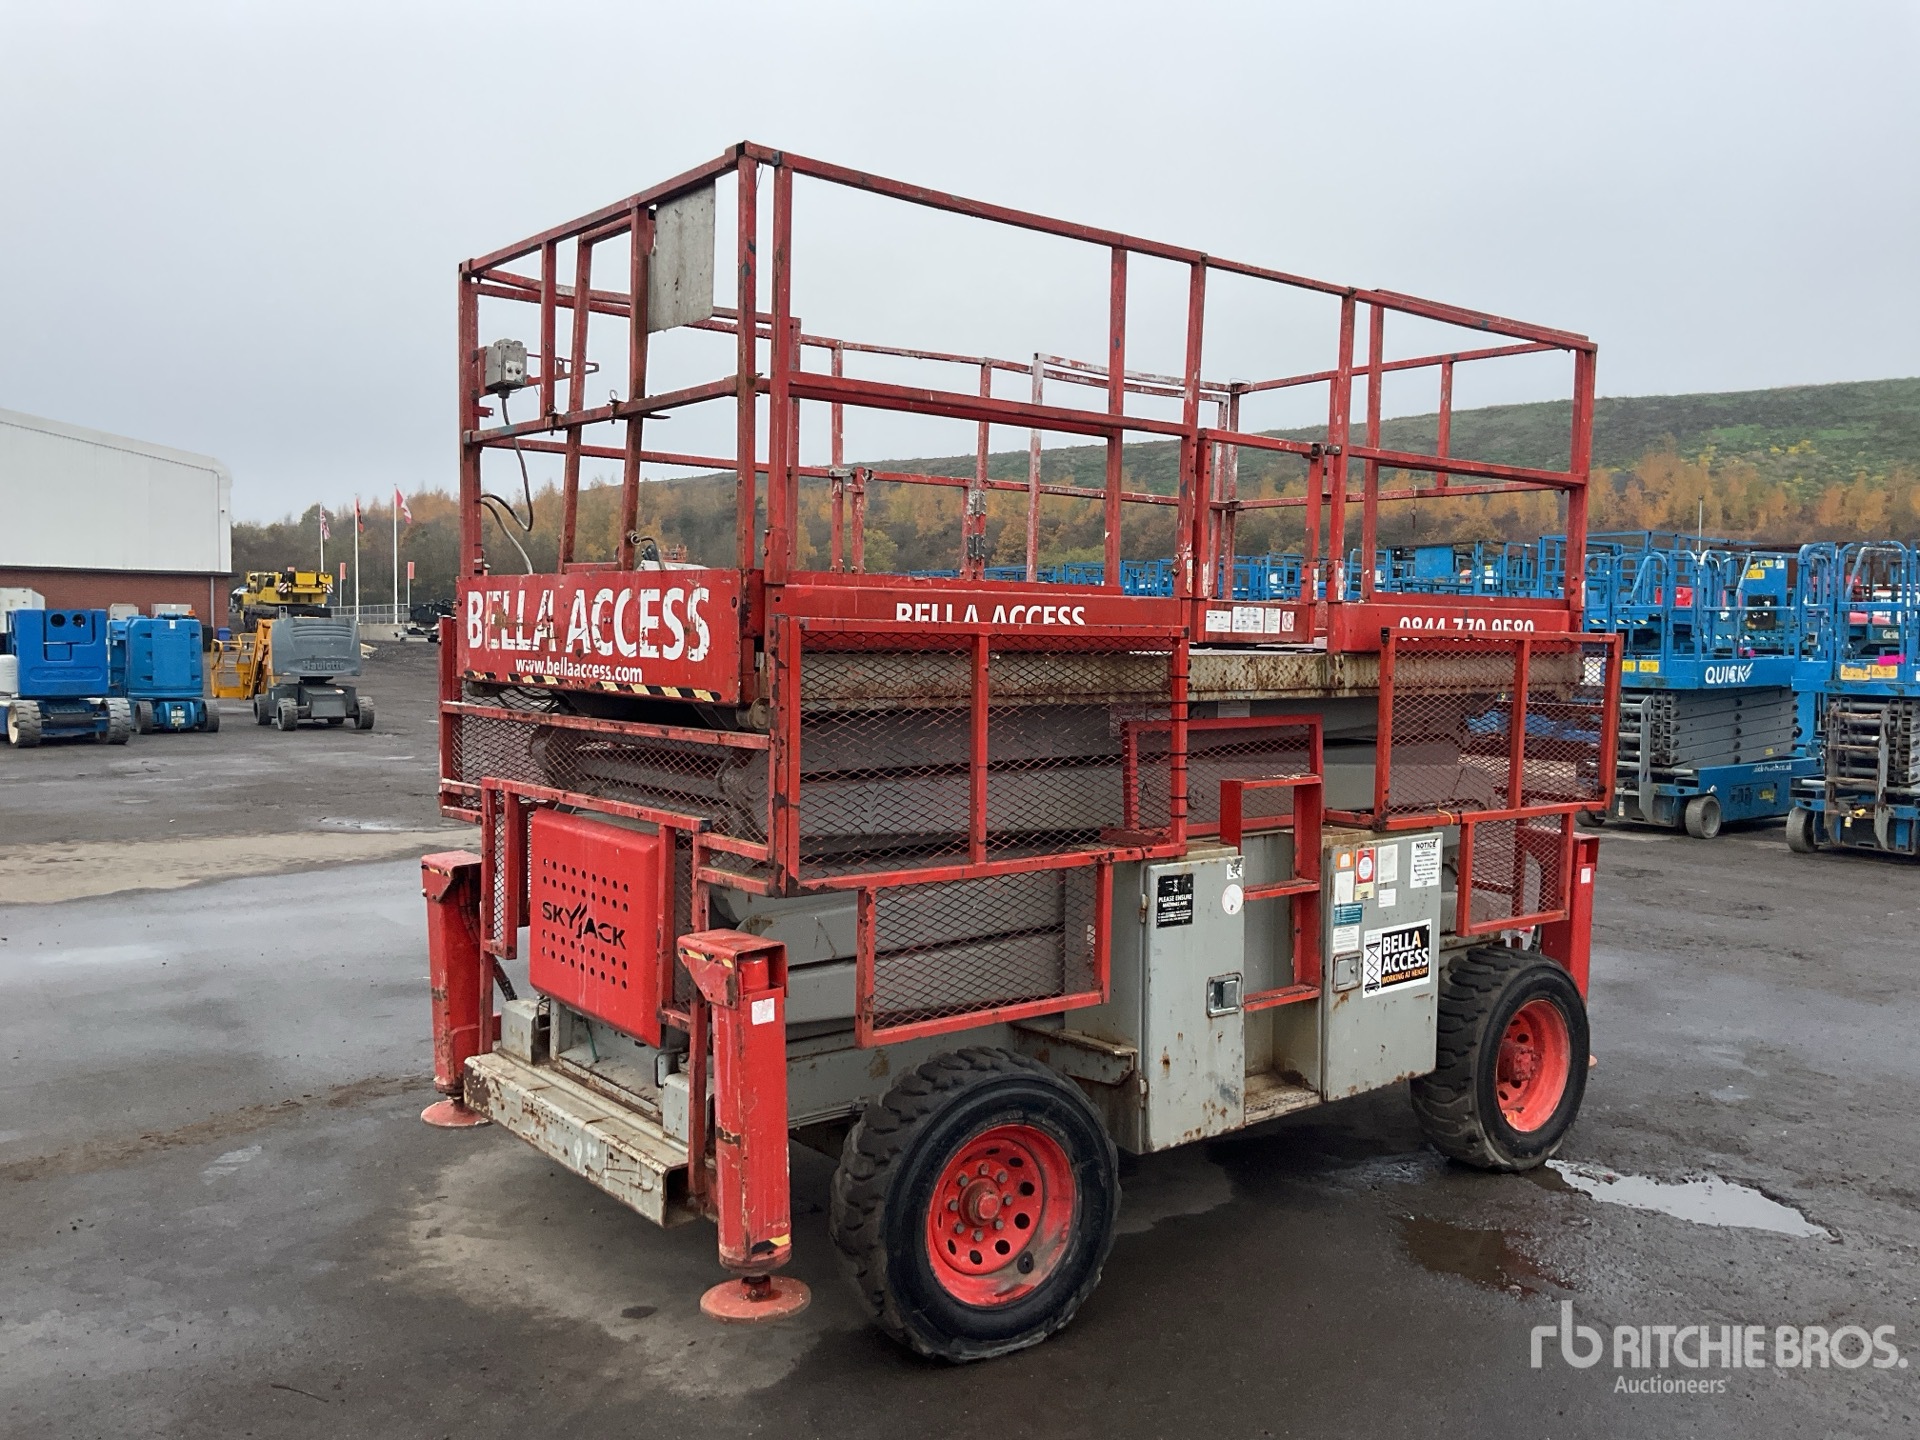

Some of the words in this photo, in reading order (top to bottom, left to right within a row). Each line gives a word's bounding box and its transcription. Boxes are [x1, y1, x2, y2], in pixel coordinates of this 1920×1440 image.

[467, 588, 557, 652] BELLA
[565, 587, 711, 662] ACCESS
[896, 602, 979, 623] BELLA
[992, 604, 1086, 626] ACCESS
[302, 660, 345, 670] Haulotte
[515, 655, 643, 683] www.bellaaccess.com
[1705, 665, 1746, 684] QUICK
[1415, 841, 1437, 849] NOTICE
[542, 901, 627, 950] SKYJACK
[1382, 930, 1422, 955] BELLA
[1381, 947, 1429, 975] ACCESS
[1381, 973, 1404, 984] WORKING
